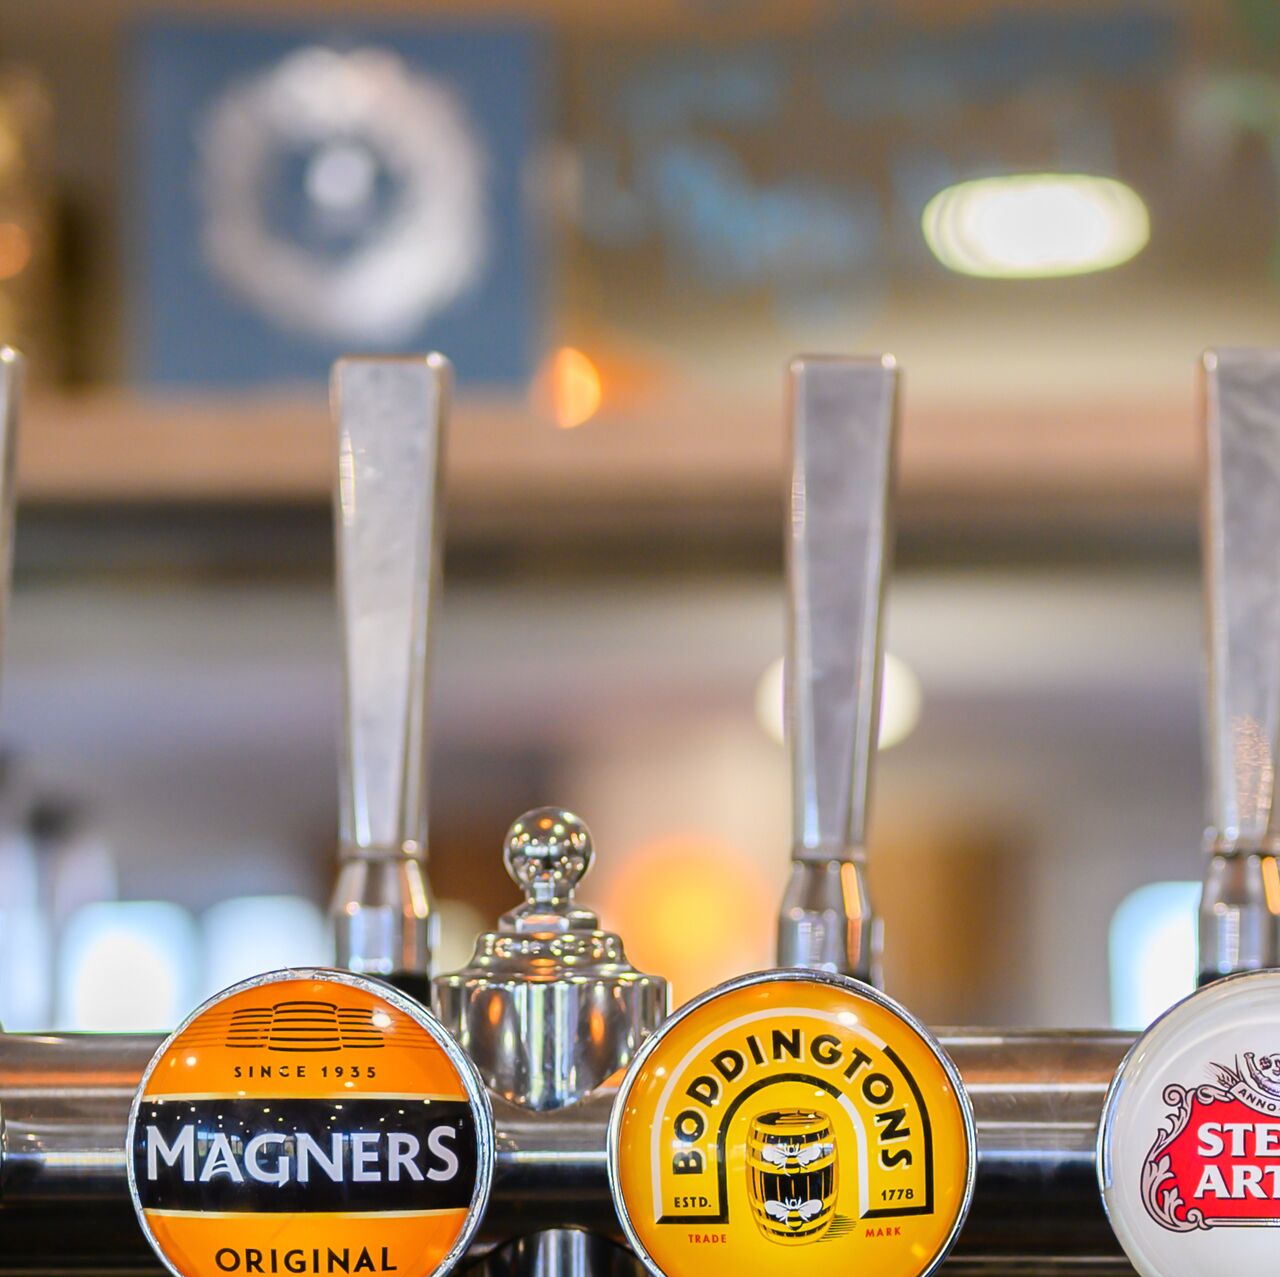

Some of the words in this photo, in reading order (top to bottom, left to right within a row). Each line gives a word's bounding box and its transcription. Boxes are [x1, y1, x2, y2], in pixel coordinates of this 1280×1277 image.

[233, 1065, 306, 1079] SINCE
[320, 1065, 377, 1079] 1935
[672, 1028, 912, 1176] BODDINGTONS
[1237, 1088, 1277, 1112] ANNO
[146, 1124, 460, 1189] MAGNERS
[880, 1188, 915, 1202] 1778
[673, 1196, 712, 1209] ESTD.
[687, 1233, 728, 1245] TRADE
[864, 1226, 902, 1239] MARK
[214, 1246, 398, 1275] ORIGINAL
